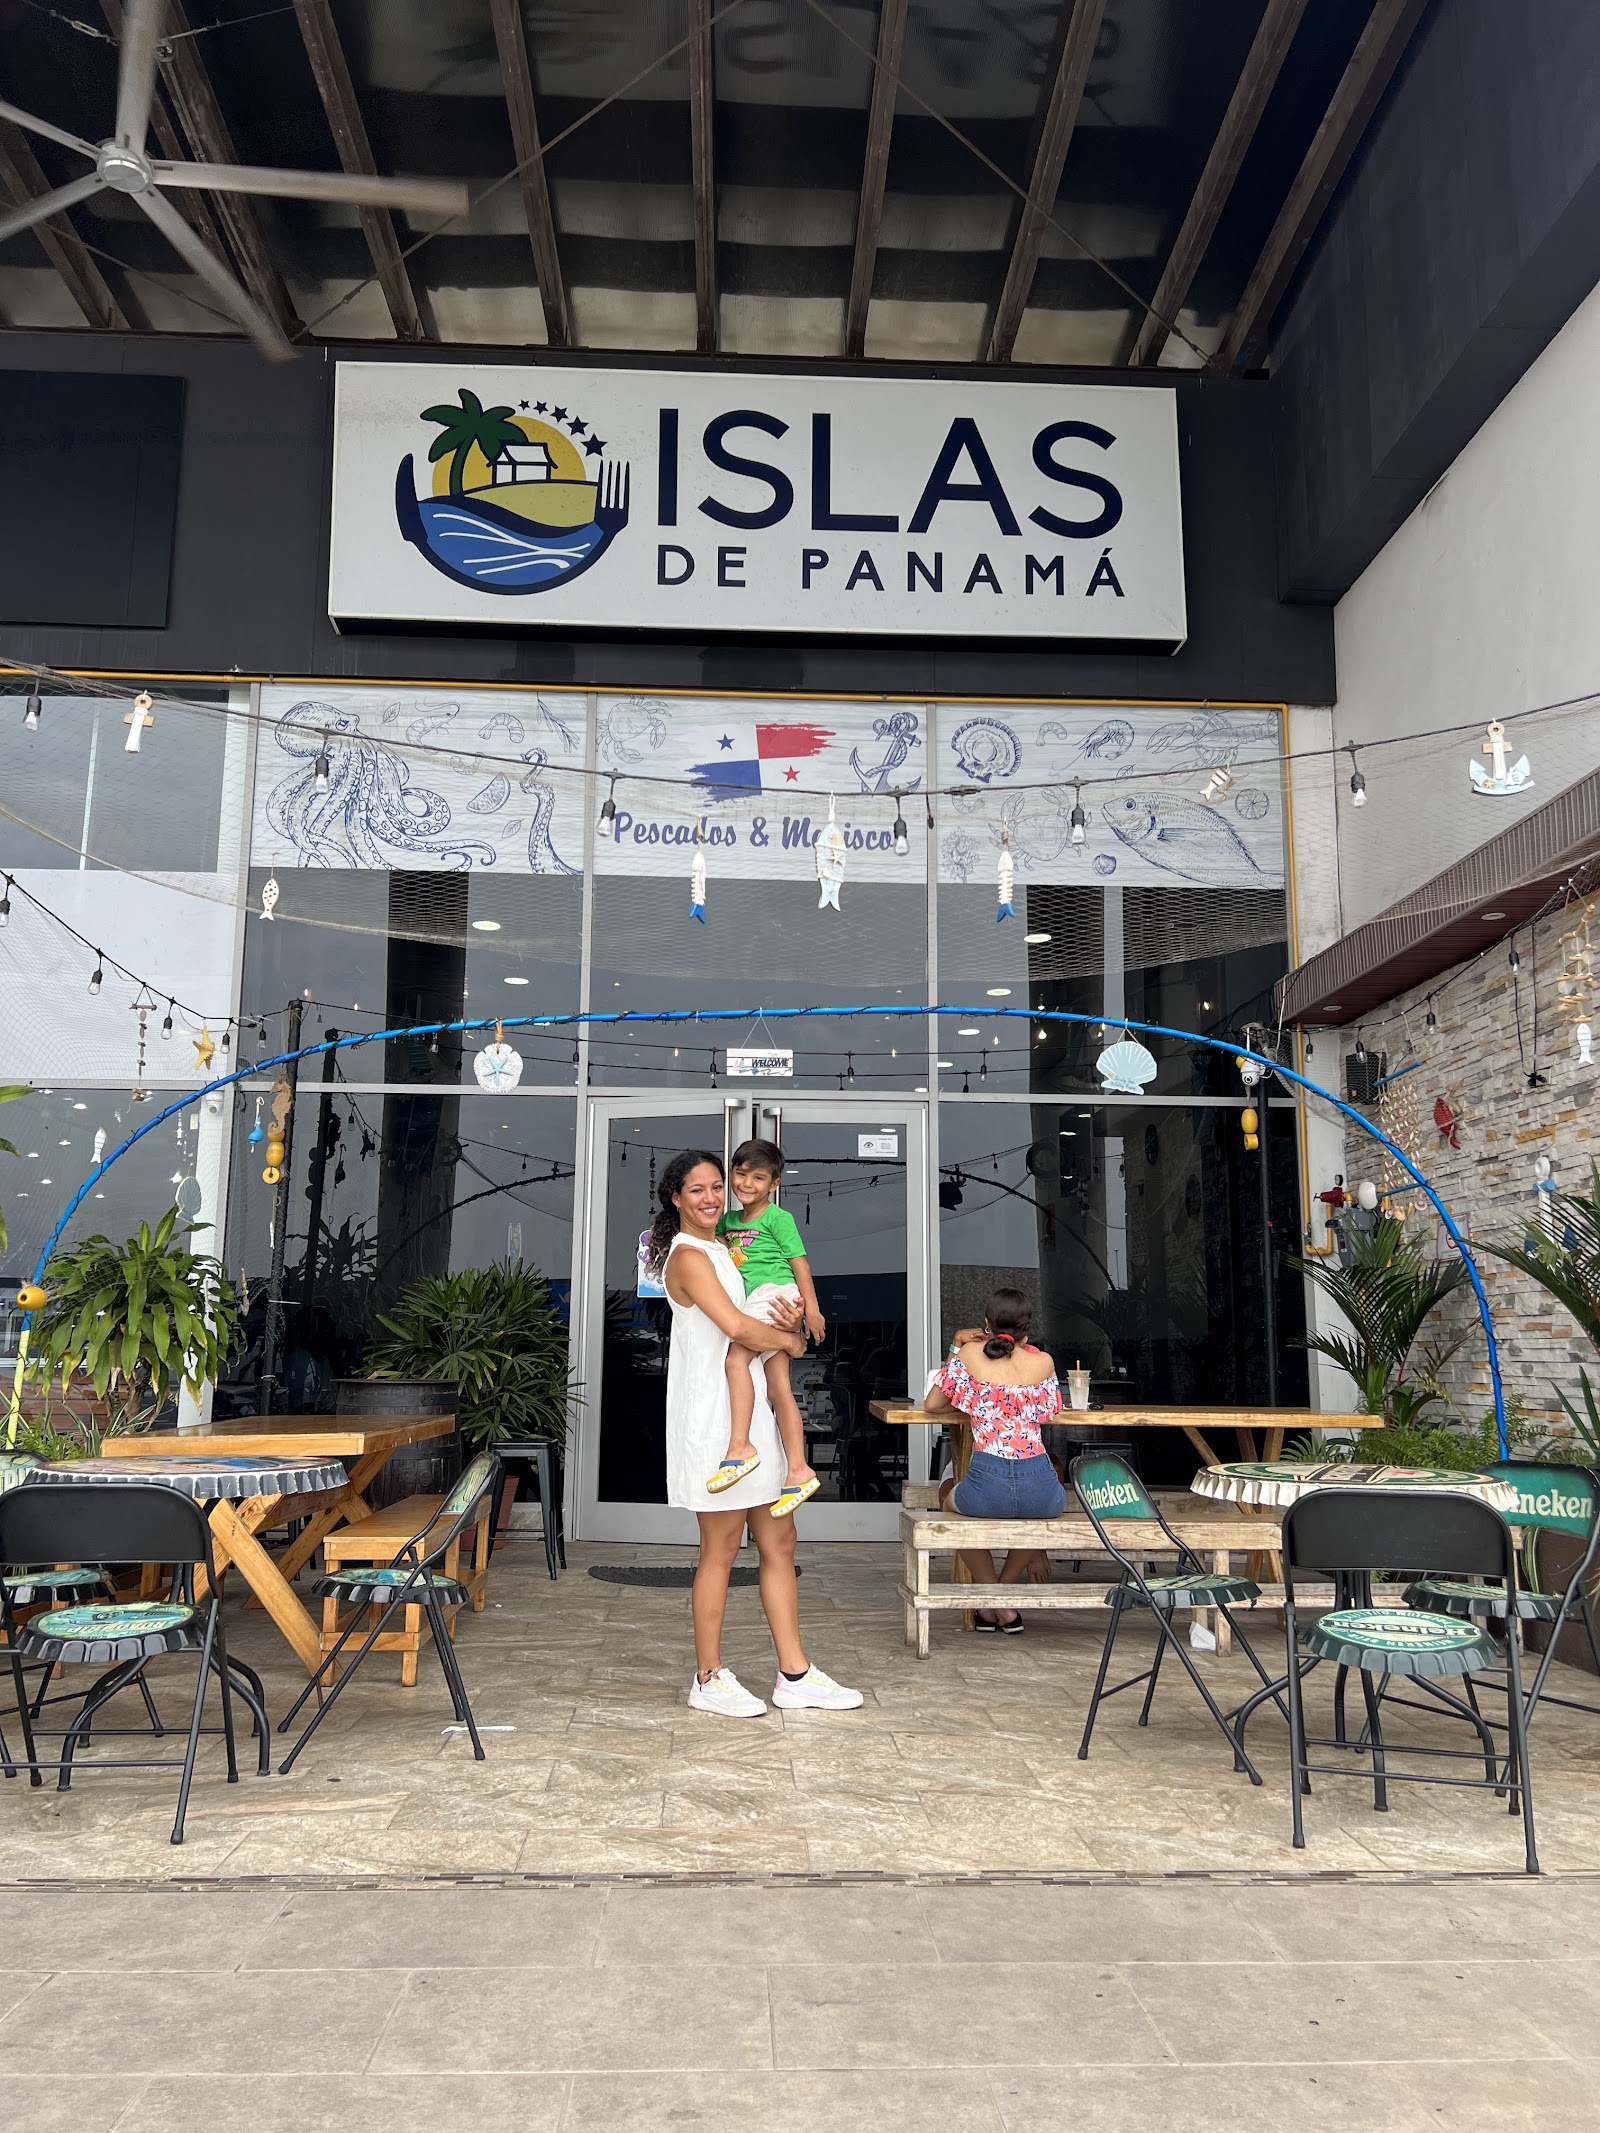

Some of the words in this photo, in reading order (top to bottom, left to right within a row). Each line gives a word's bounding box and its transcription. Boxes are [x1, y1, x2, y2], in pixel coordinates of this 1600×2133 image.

[657, 408, 1123, 539] ISLAS
[657, 545, 747, 588] DE
[802, 547, 1125, 598] PANAMÁ
[613, 811, 737, 847] Pescados
[750, 816, 769, 848] &
[782, 816, 900, 850] Misco
[752, 1058, 788, 1067] WELCOME
[1333, 1621, 1466, 1636] Heineken
